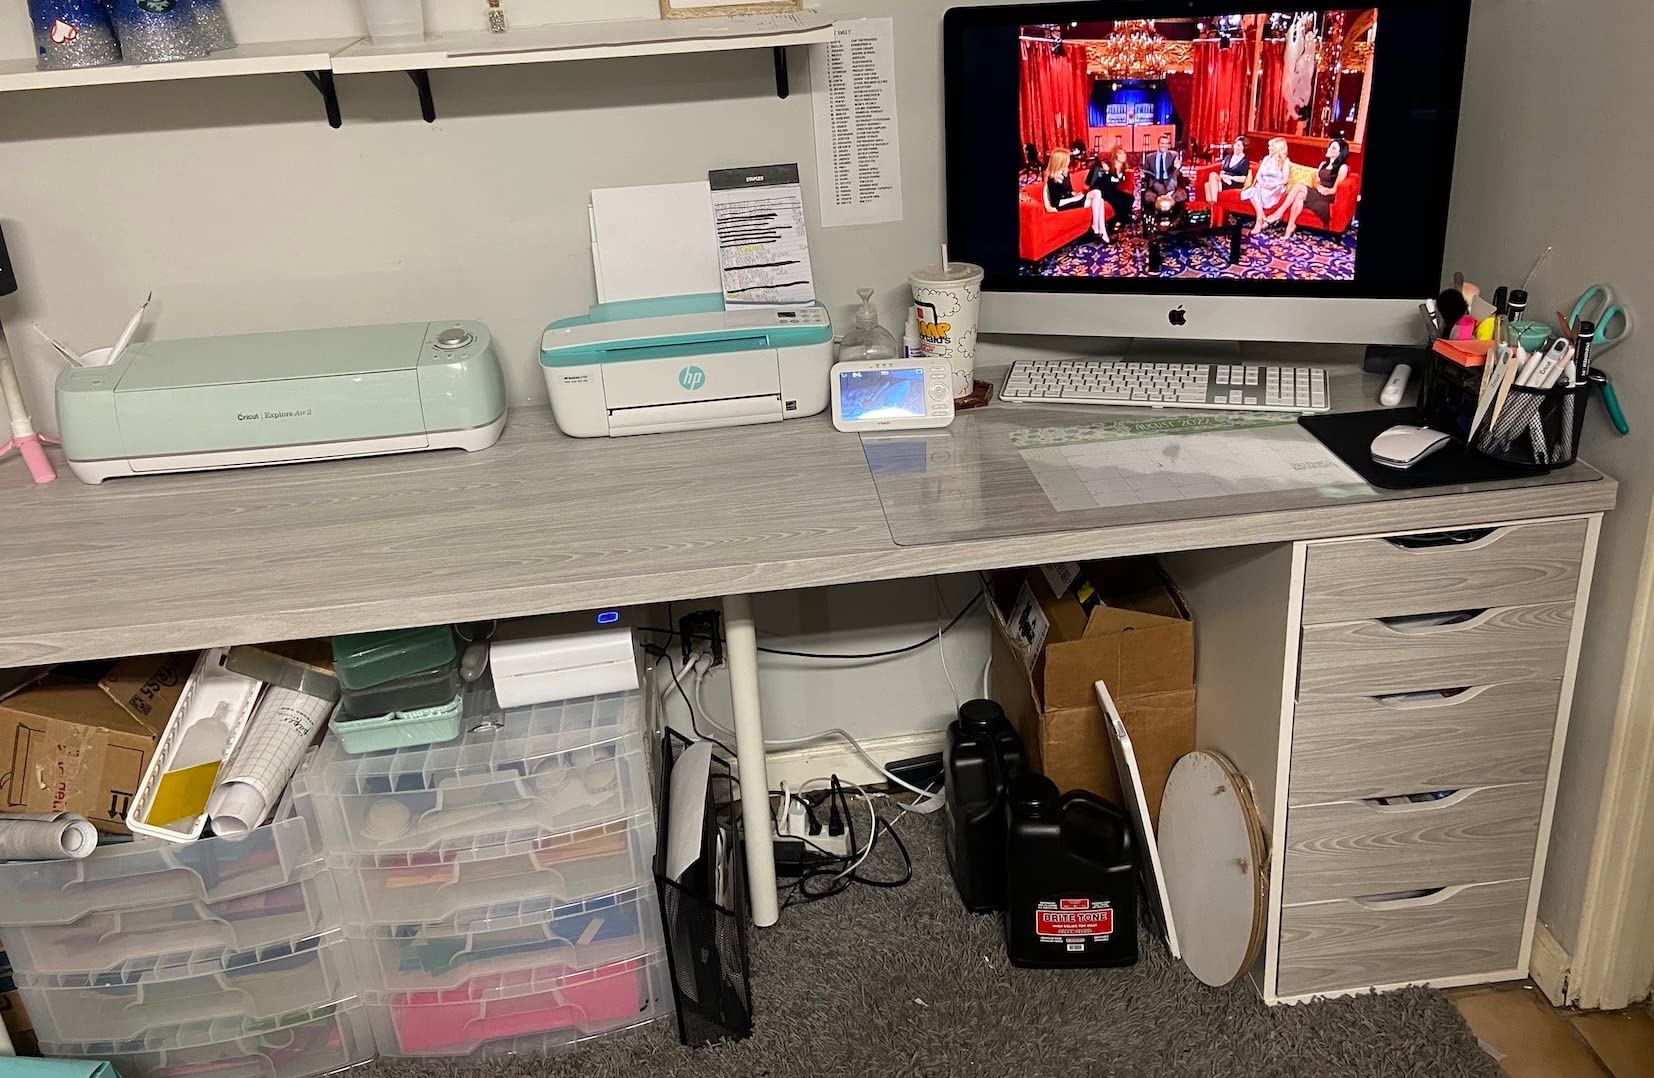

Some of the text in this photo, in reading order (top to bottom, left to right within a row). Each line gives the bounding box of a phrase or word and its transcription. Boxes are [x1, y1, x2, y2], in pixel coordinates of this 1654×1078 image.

[682, 365, 703, 390] hp
[237, 413, 260, 421] Cricut
[264, 410, 294, 419] Explore
[294, 409, 306, 417] Air
[1135, 415, 1210, 432] AUGUST 2022
[1043, 912, 1107, 922] BRITE TONE
